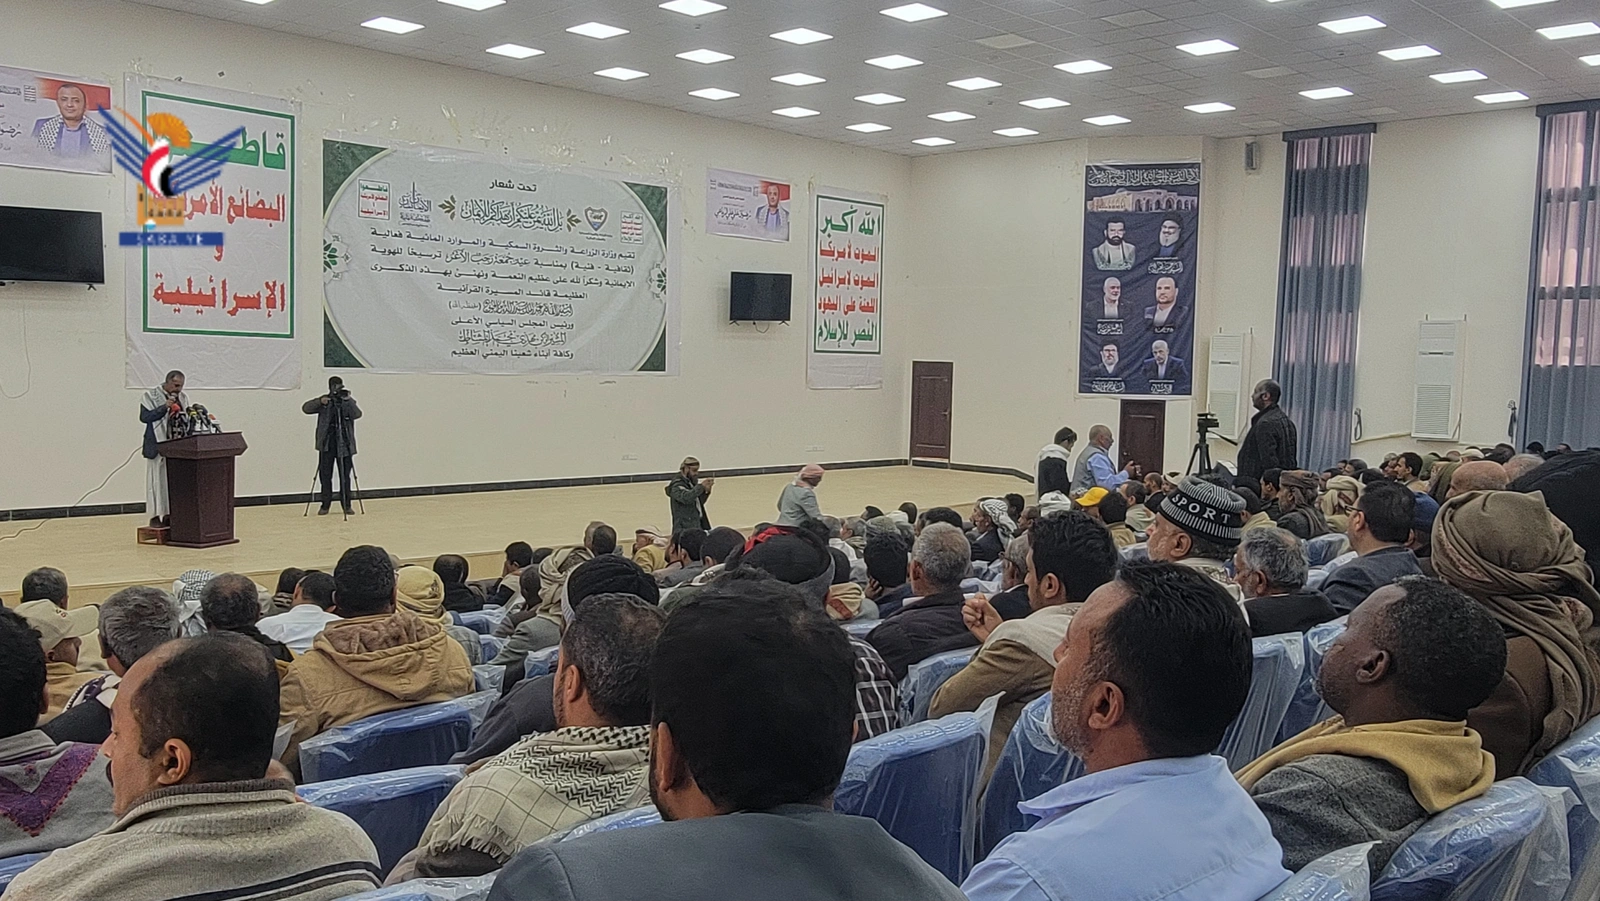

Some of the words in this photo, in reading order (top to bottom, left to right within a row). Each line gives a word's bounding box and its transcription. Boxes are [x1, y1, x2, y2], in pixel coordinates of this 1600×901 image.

[489, 179, 515, 190] شعار
[517, 183, 537, 192] تحت
[226, 186, 286, 228] البضائع
[820, 204, 858, 238] أكبر
[858, 210, 881, 236] الله
[370, 227, 403, 238] فعالية
[447, 236, 486, 247] والموارد
[370, 244, 402, 256] للهوية
[570, 246, 600, 257] الزراعة
[601, 249, 617, 259] وزارة
[618, 251, 636, 260] تقيم
[854, 246, 880, 264] الموت
[370, 263, 417, 273] الذكرى
[534, 258, 567, 269] بمناسبة
[419, 265, 452, 277] بهذه
[491, 270, 526, 280] النعمة
[528, 274, 551, 283] عظيم
[553, 276, 568, 284] على
[853, 272, 879, 291] الموت
[153, 272, 286, 318] الإسرائيلية
[485, 285, 523, 296] المسيرة
[525, 289, 551, 298] قائد
[553, 289, 588, 300] العظيمة
[818, 295, 841, 315] اليهود
[844, 295, 856, 315] على
[859, 296, 878, 314] اللعنة
[485, 318, 516, 328] السياسي
[518, 320, 548, 329] المجلس
[550, 321, 574, 330] ورئيس
[818, 319, 849, 348] للإسلام
[851, 319, 878, 347] النصر
[451, 348, 479, 358] العظيم
[482, 349, 508, 359] اليمني
[510, 349, 532, 359] شعبنا
[534, 348, 551, 359] أبناء
[553, 349, 574, 360] وكافة
[1171, 493, 1231, 524] SPORT
